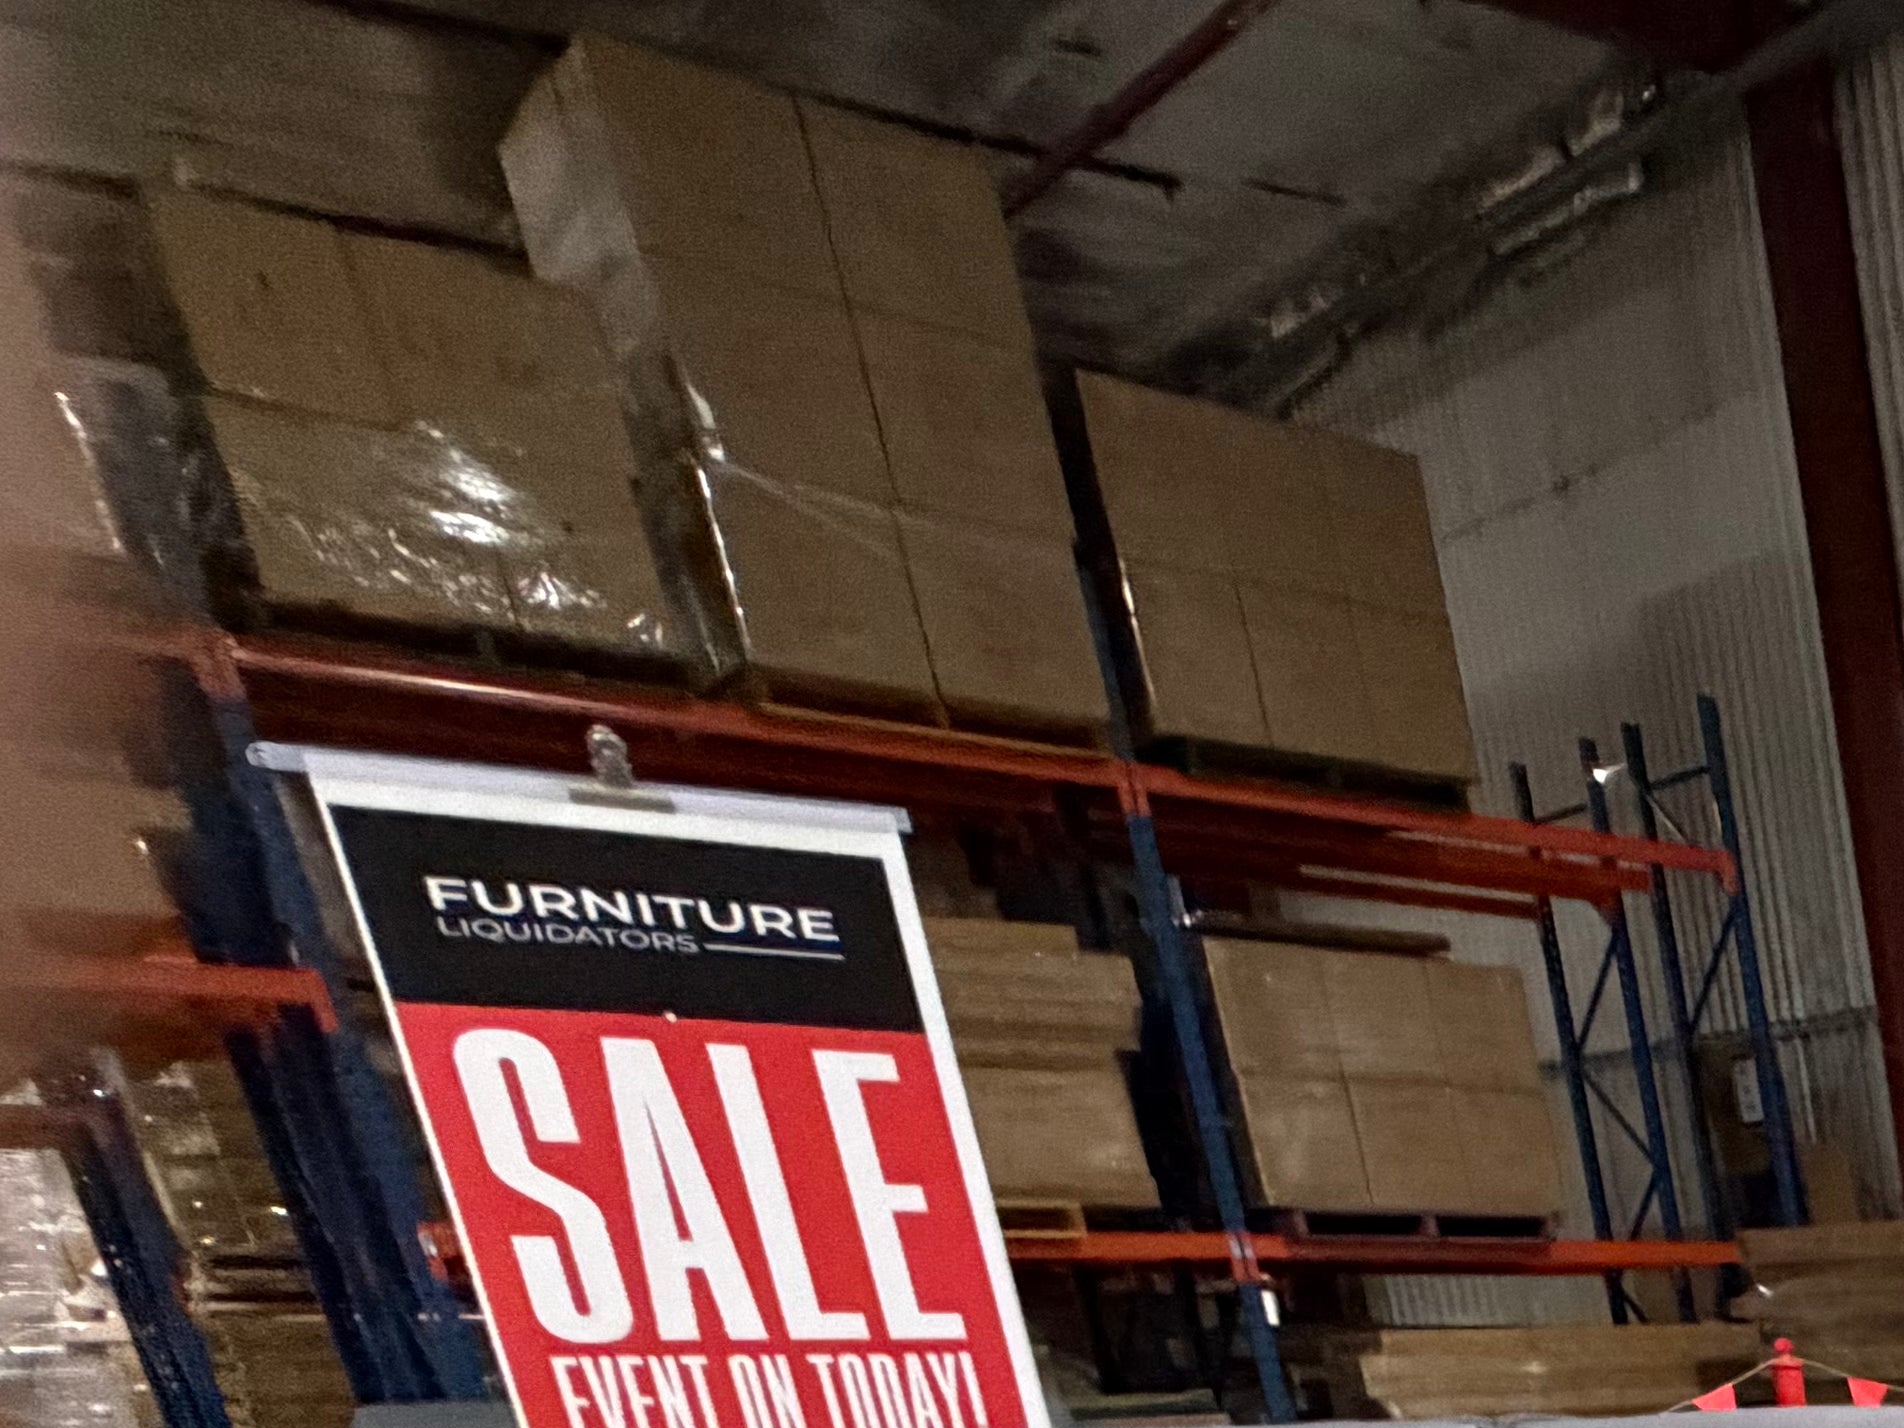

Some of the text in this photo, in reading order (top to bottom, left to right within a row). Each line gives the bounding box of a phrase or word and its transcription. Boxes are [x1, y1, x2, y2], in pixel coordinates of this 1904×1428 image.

[423, 875, 840, 942] FURNITURE
[435, 915, 700, 954] LIQUIDATORS
[453, 1028, 967, 1344] SALE
